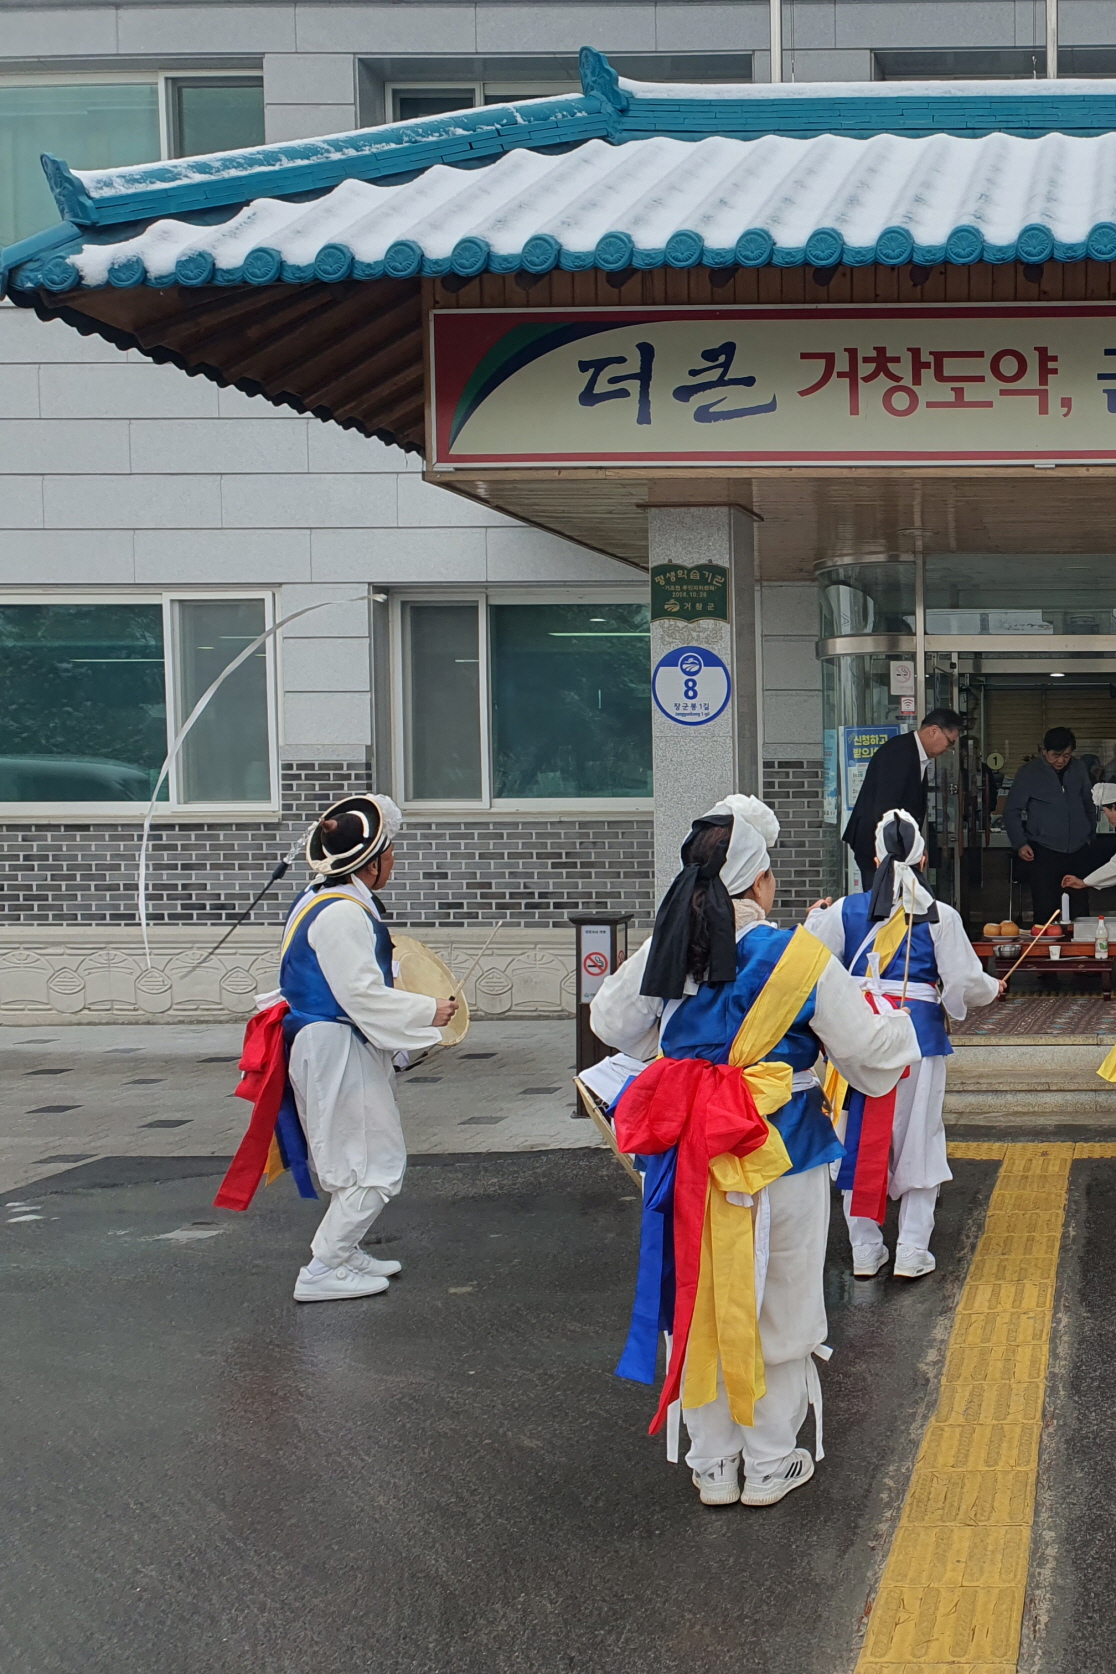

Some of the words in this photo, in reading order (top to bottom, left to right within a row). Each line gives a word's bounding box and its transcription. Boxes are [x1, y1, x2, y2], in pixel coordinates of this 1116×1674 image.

[577, 341, 655, 425] 더
[671, 341, 778, 424] 큰
[796, 346, 1073, 418] 거창도약,
[683, 603, 715, 611] 거창군
[683, 678, 699, 701] 8
[853, 734, 889, 746] 신청하고
